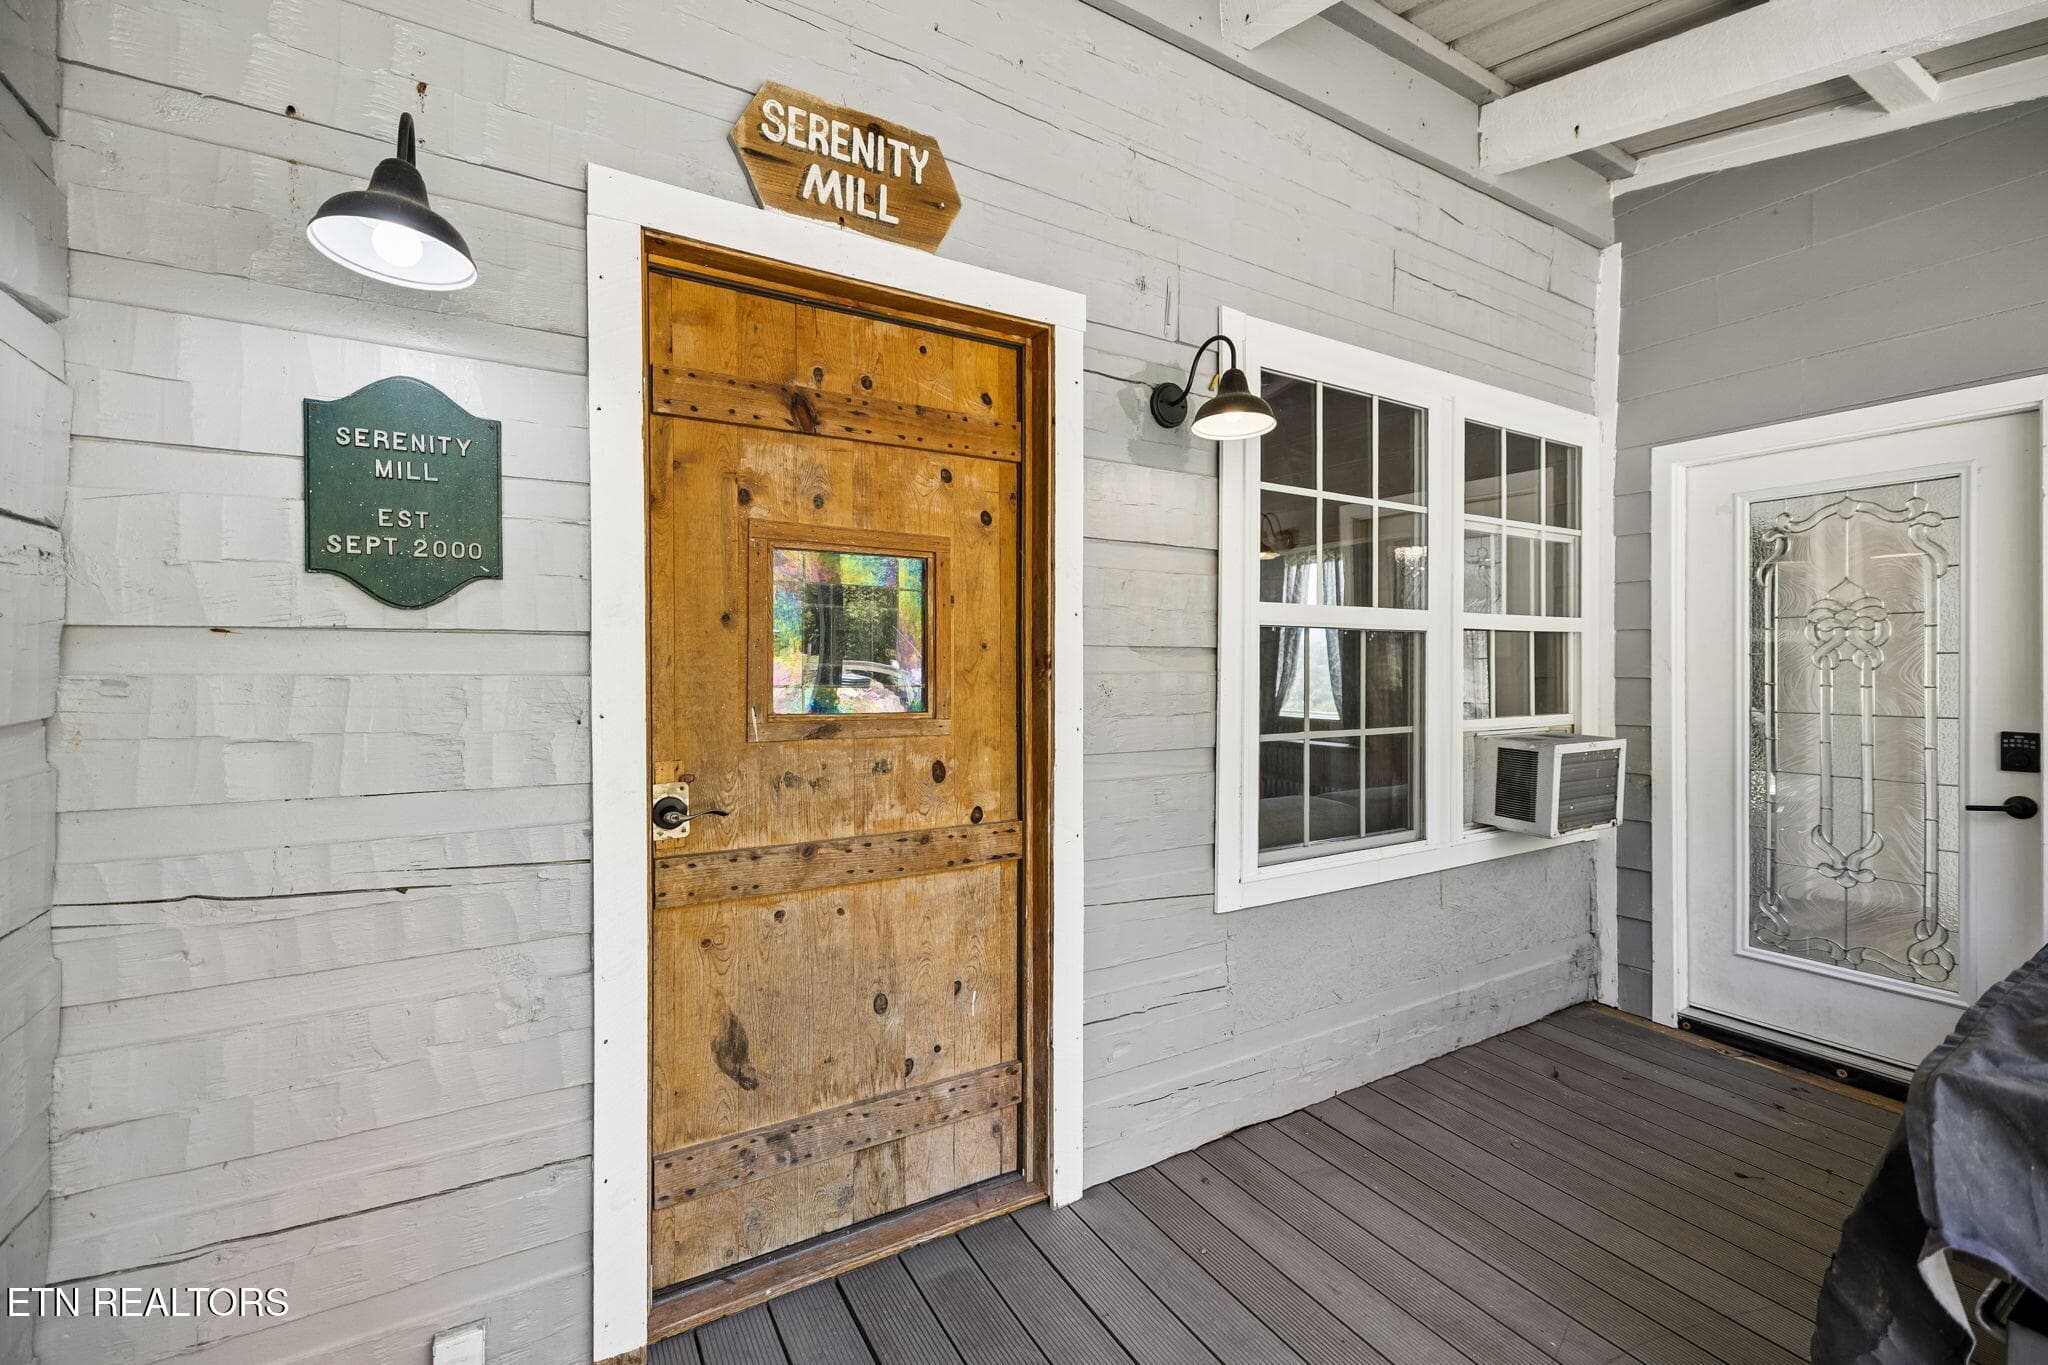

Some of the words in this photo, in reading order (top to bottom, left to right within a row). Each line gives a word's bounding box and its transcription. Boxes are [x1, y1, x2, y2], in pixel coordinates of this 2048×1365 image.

[761, 99, 929, 184] SERENITY
[802, 164, 899, 224] MILL
[335, 426, 472, 457] SERENITY
[375, 458, 439, 482] MILL
[378, 508, 430, 529] EST
[326, 534, 398, 556] SEPT
[413, 538, 483, 561] 2000
